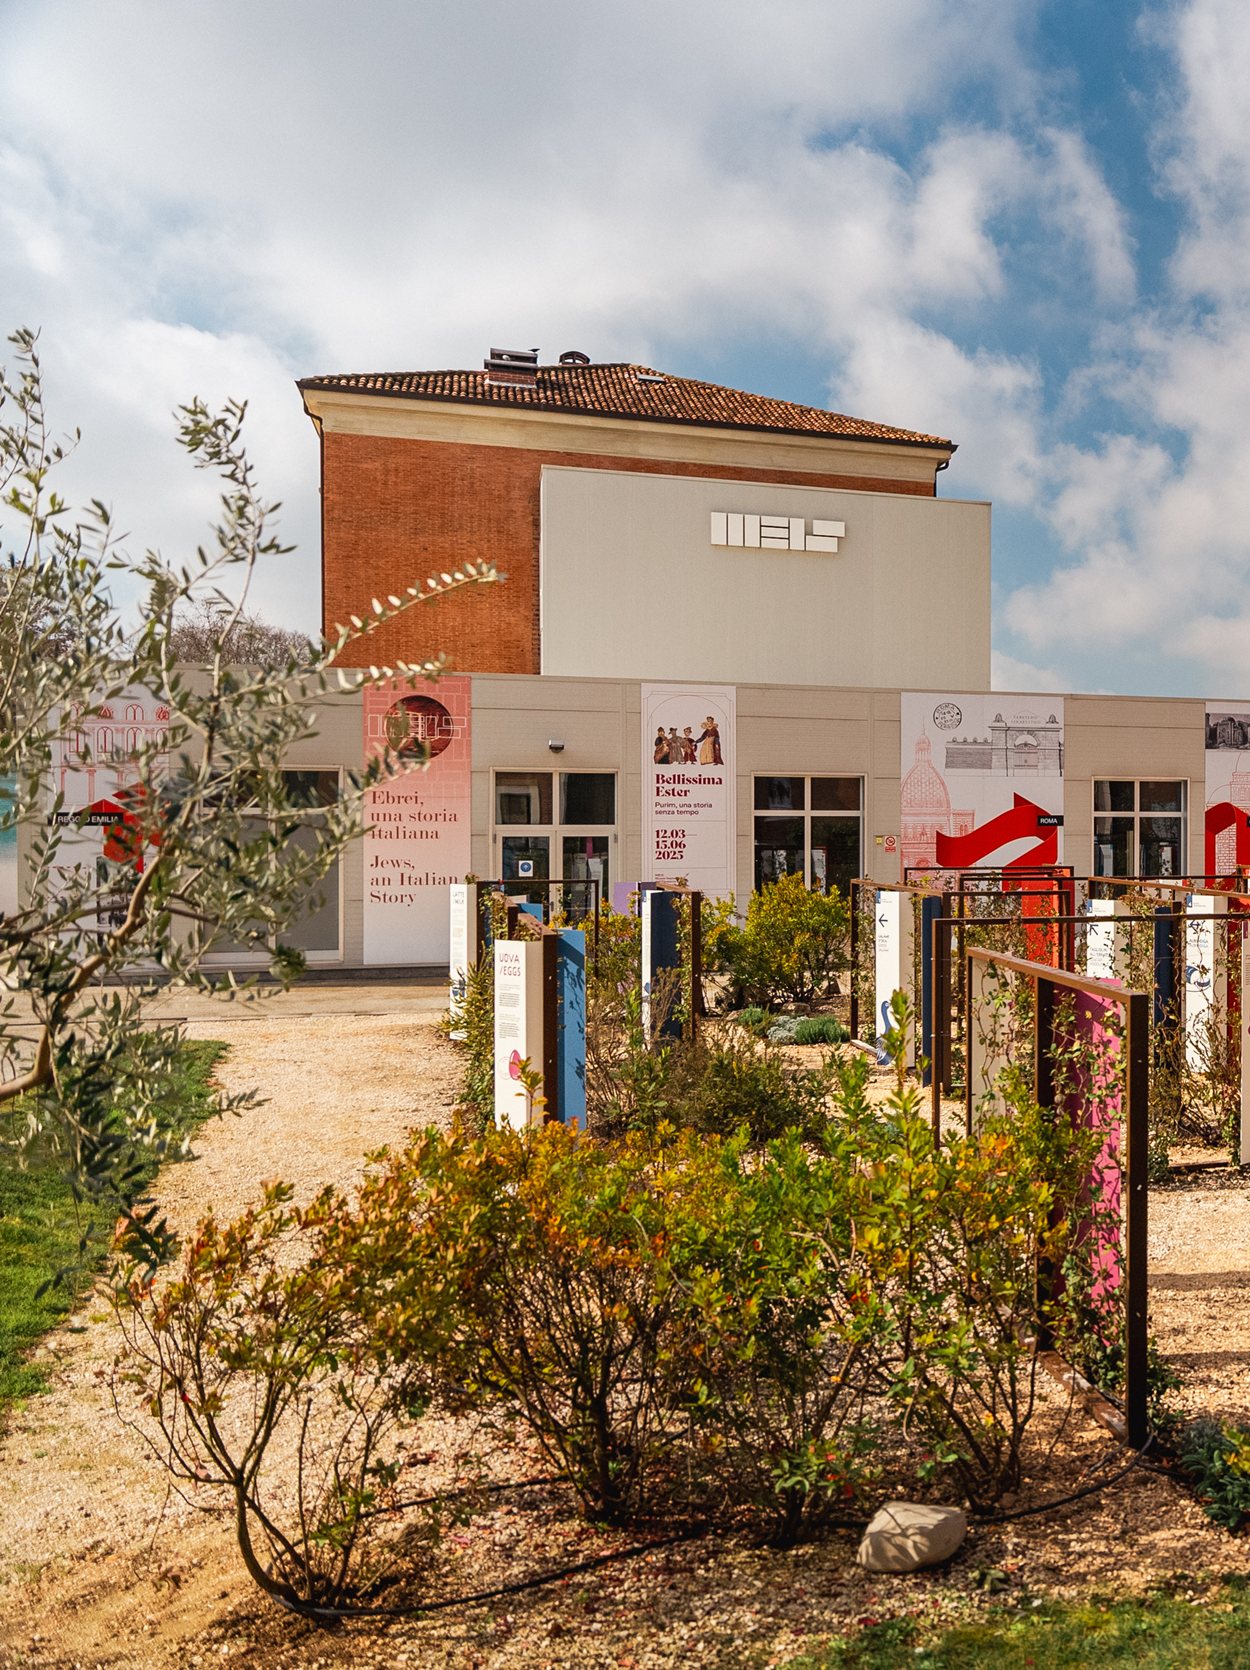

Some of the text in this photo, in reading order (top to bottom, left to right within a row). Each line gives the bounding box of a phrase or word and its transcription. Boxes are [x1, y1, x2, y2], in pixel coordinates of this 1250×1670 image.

[655, 773, 723, 785] Bellissima
[655, 786, 690, 797] Ester
[371, 790, 424, 808] Ebrei,
[58, 815, 119, 823] REGGO EMILIA
[370, 808, 458, 822] una storia
[371, 826, 440, 839] italiana
[655, 840, 687, 849] 15.06
[655, 850, 684, 860] 2025
[370, 855, 416, 871] Jews,
[370, 872, 459, 886] an Italian
[370, 890, 417, 907] Story
[499, 953, 520, 963] UOVA
[499, 966, 521, 977] /EGGS
